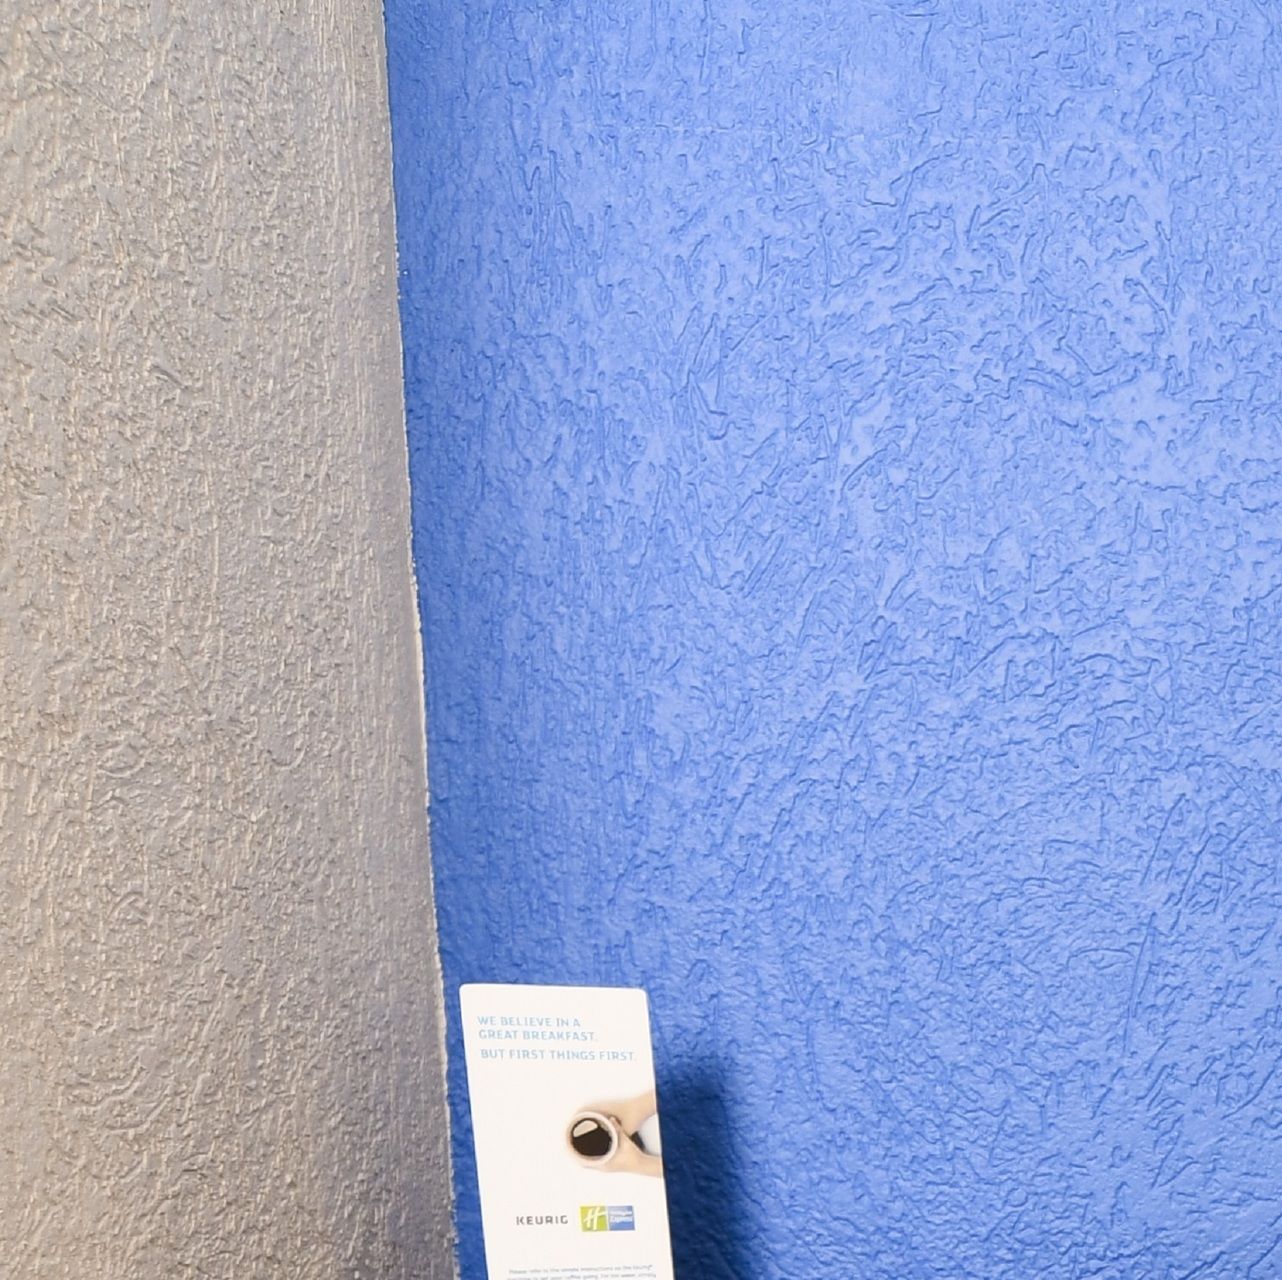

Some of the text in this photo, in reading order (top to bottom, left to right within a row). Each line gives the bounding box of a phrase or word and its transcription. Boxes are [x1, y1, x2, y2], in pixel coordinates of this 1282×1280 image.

[477, 1016, 581, 1027] WE BELIEVE IN A
[478, 1029, 599, 1042] GREAT BREAKFAST.
[480, 1048, 637, 1062] BUT FIRST THINGS FIRST.
[516, 1214, 569, 1226] KEURIG
